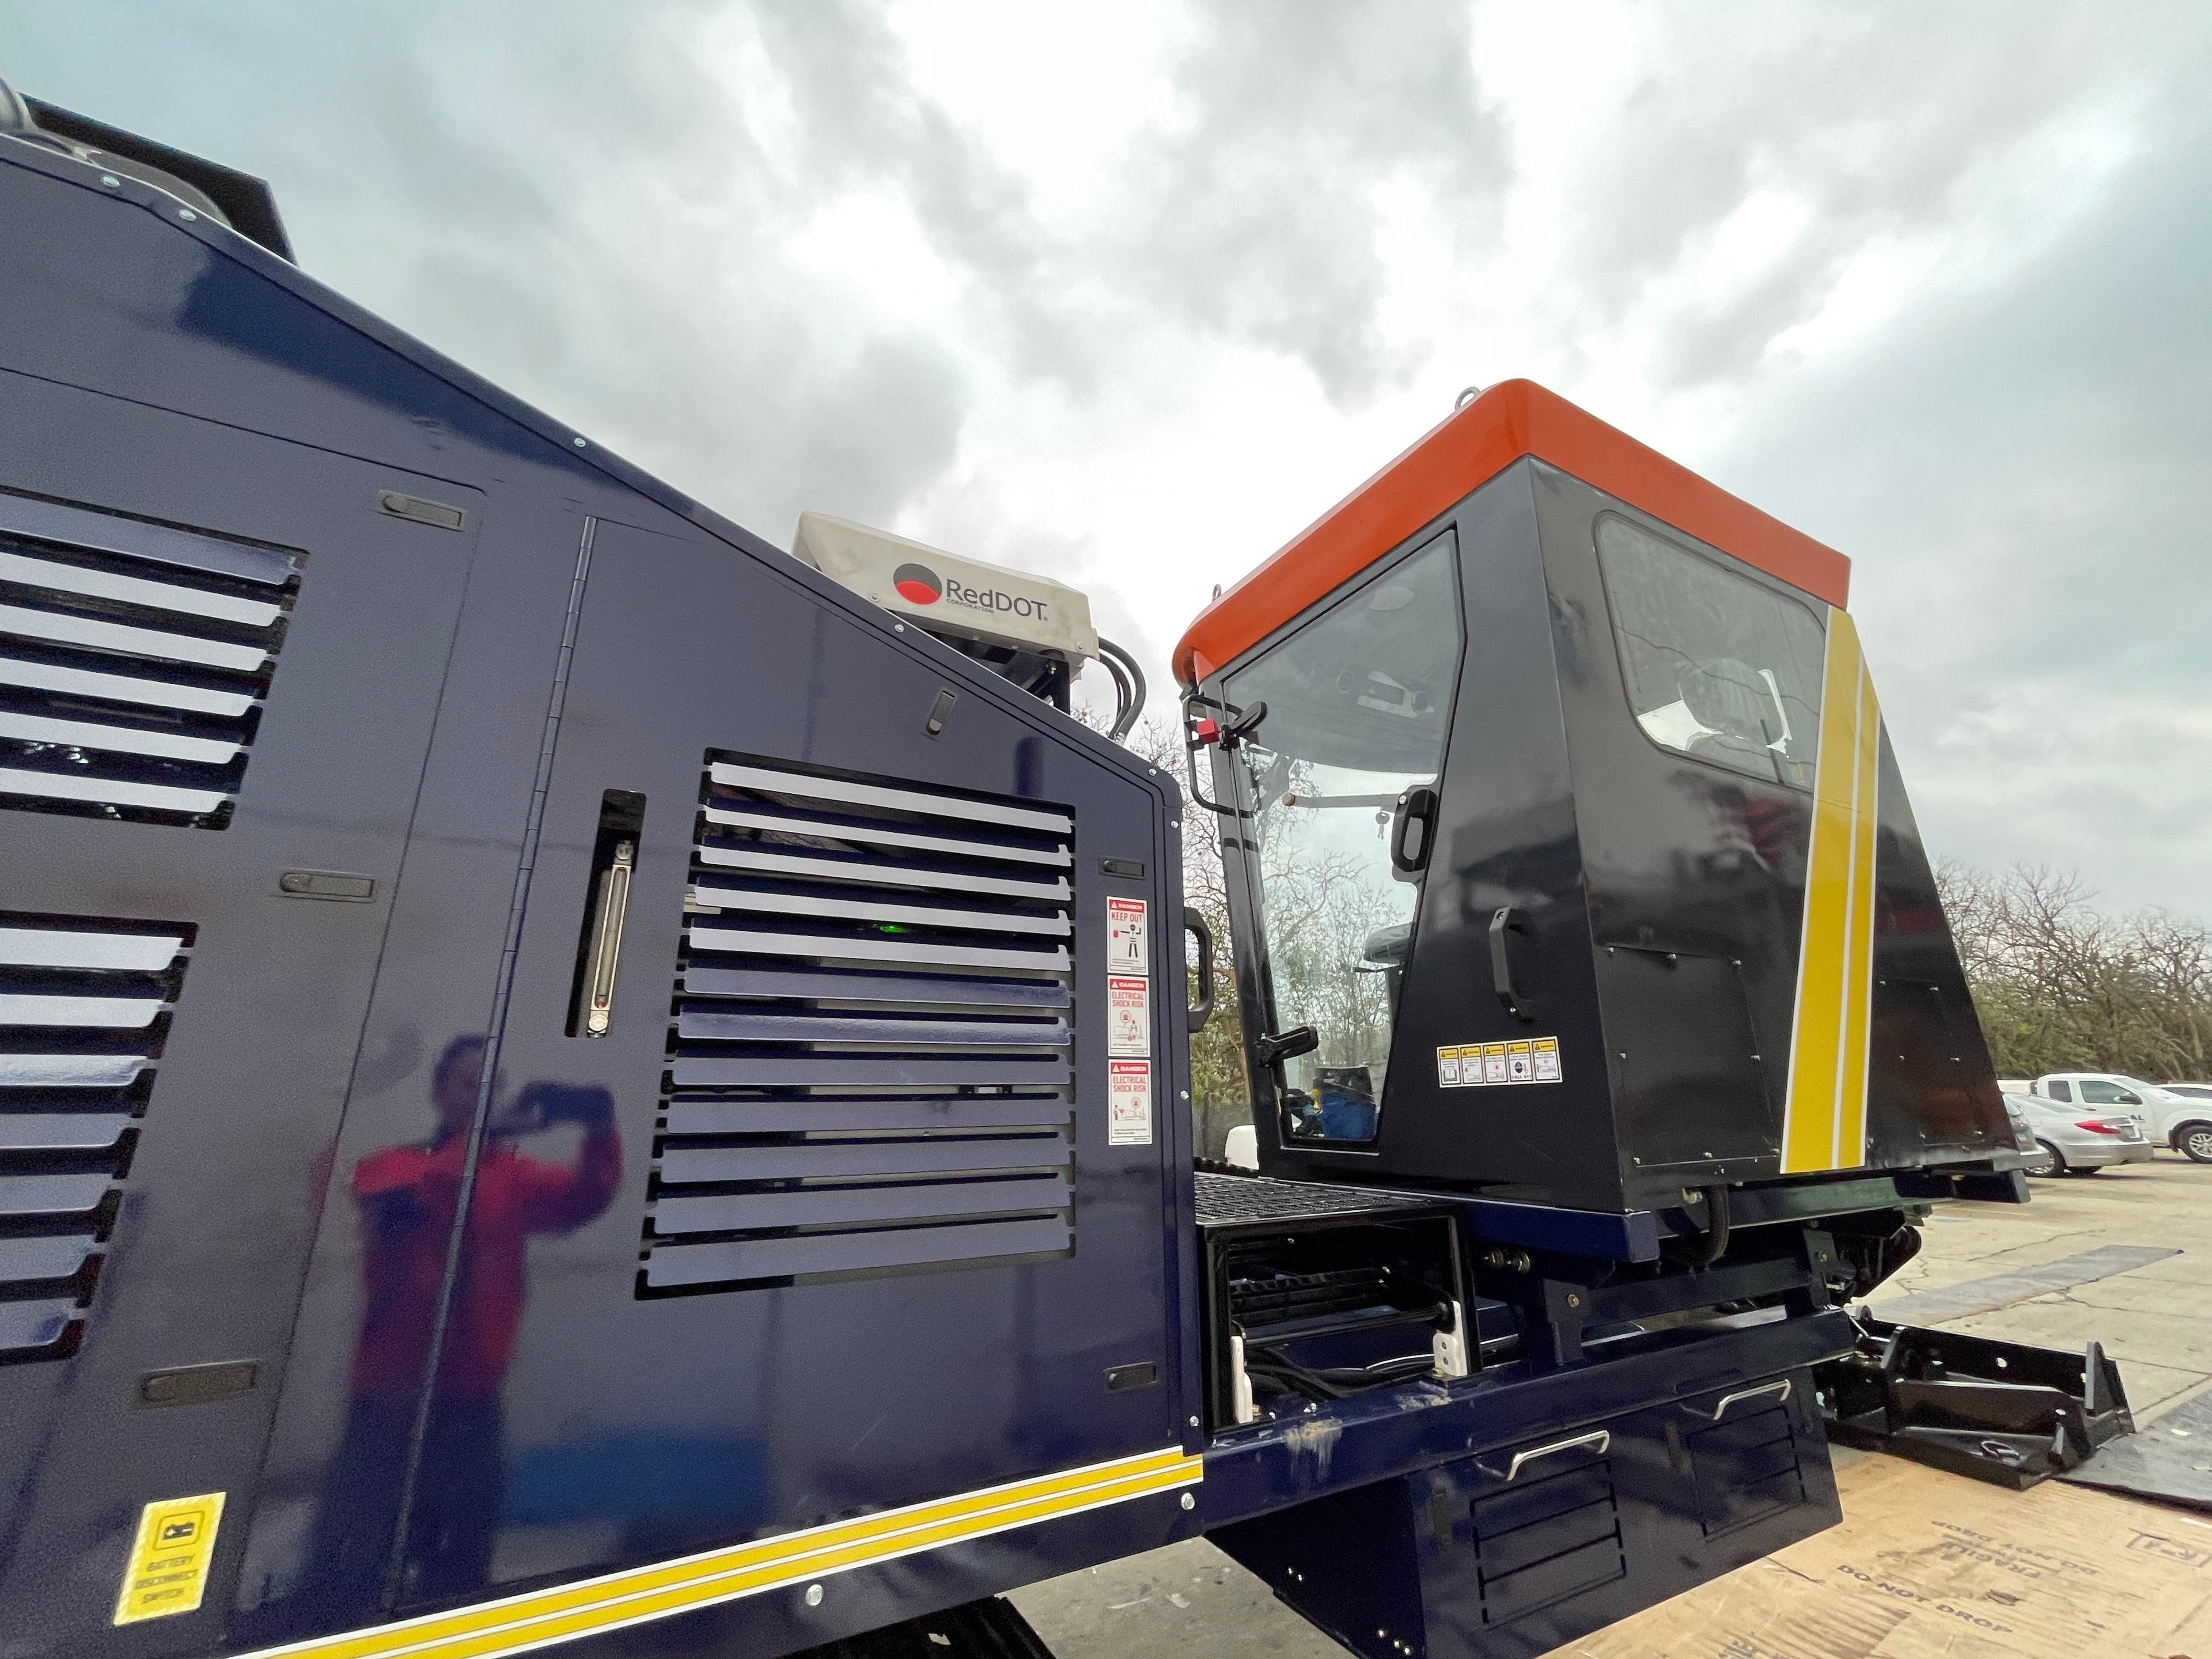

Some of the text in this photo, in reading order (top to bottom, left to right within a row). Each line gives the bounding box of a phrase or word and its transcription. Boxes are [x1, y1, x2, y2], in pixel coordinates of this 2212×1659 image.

[946, 599, 994, 614] CORPORATION
[1111, 912, 1142, 923] KEEP OUT
[1112, 991, 1144, 1000] ELECTRICAL
[1113, 1076, 1146, 1084] ELECTRICAL
[1134, 1085, 1146, 1093] RISK
[1837, 1565, 2013, 1633] DO NOT DROP
